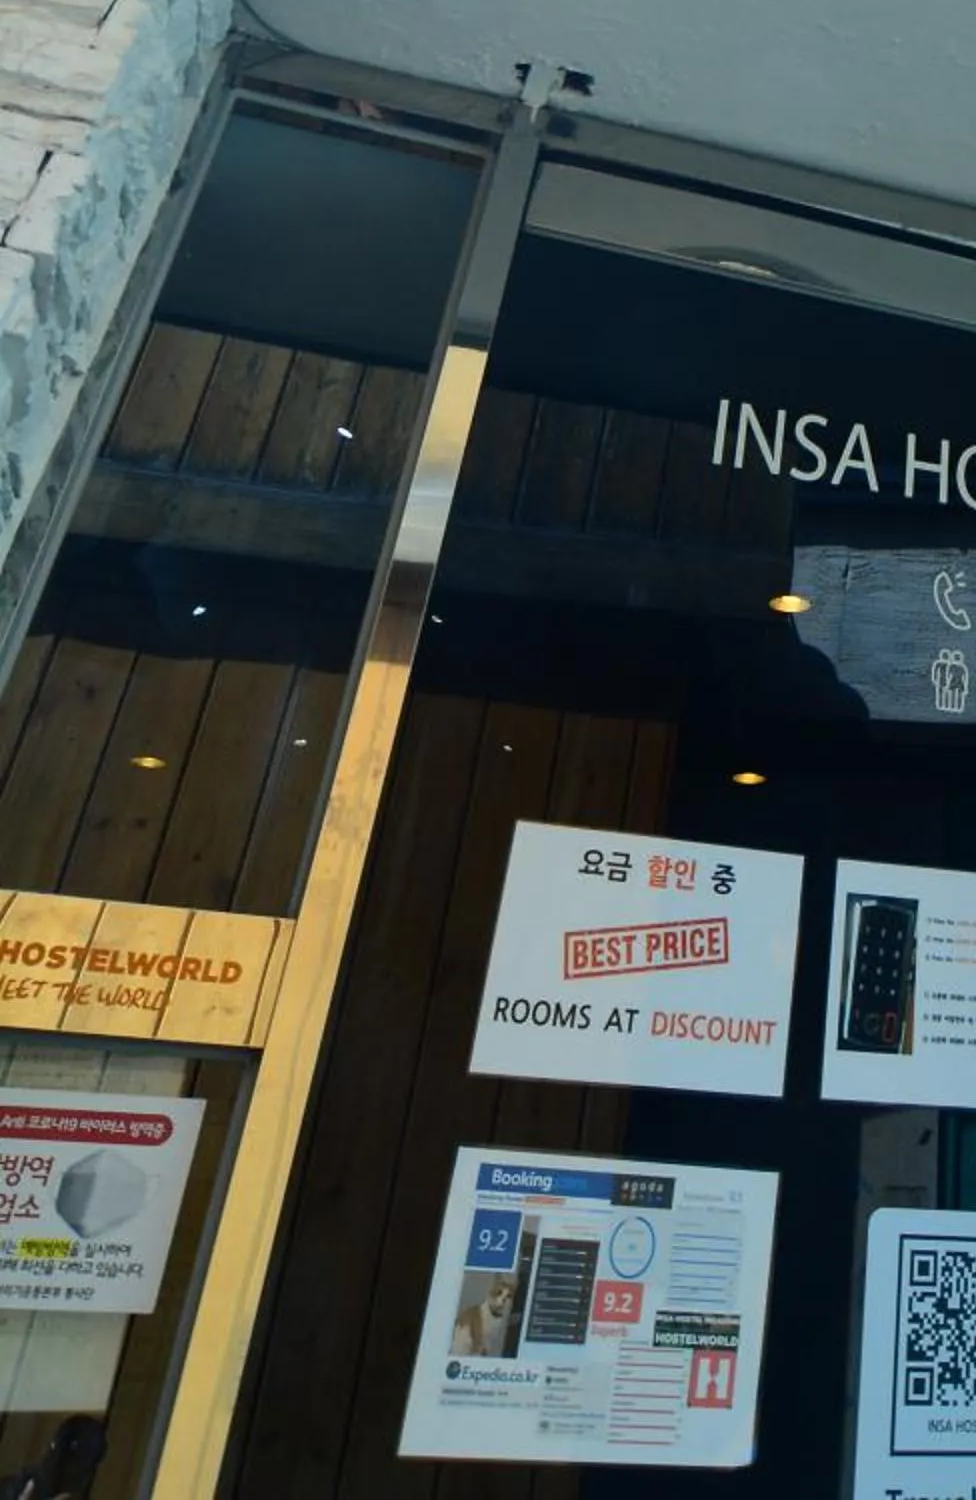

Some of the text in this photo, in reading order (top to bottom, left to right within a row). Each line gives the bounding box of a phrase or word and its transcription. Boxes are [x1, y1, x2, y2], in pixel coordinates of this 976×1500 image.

[712, 399, 878, 493] INSA
[578, 849, 736, 895] 요금 할인 중
[0, 939, 243, 984] HOSTELWORLD
[573, 927, 721, 970] BEST PRICE
[0, 974, 168, 1011] EET THE WORLD
[493, 997, 778, 1045] ROOMS AT DISCOUNT
[0, 1155, 54, 1187] 방역
[491, 1168, 553, 1191] Booking
[477, 1229, 509, 1252] 9.2
[603, 1291, 634, 1314] 9.2
[927, 1419, 953, 1433] INSA
